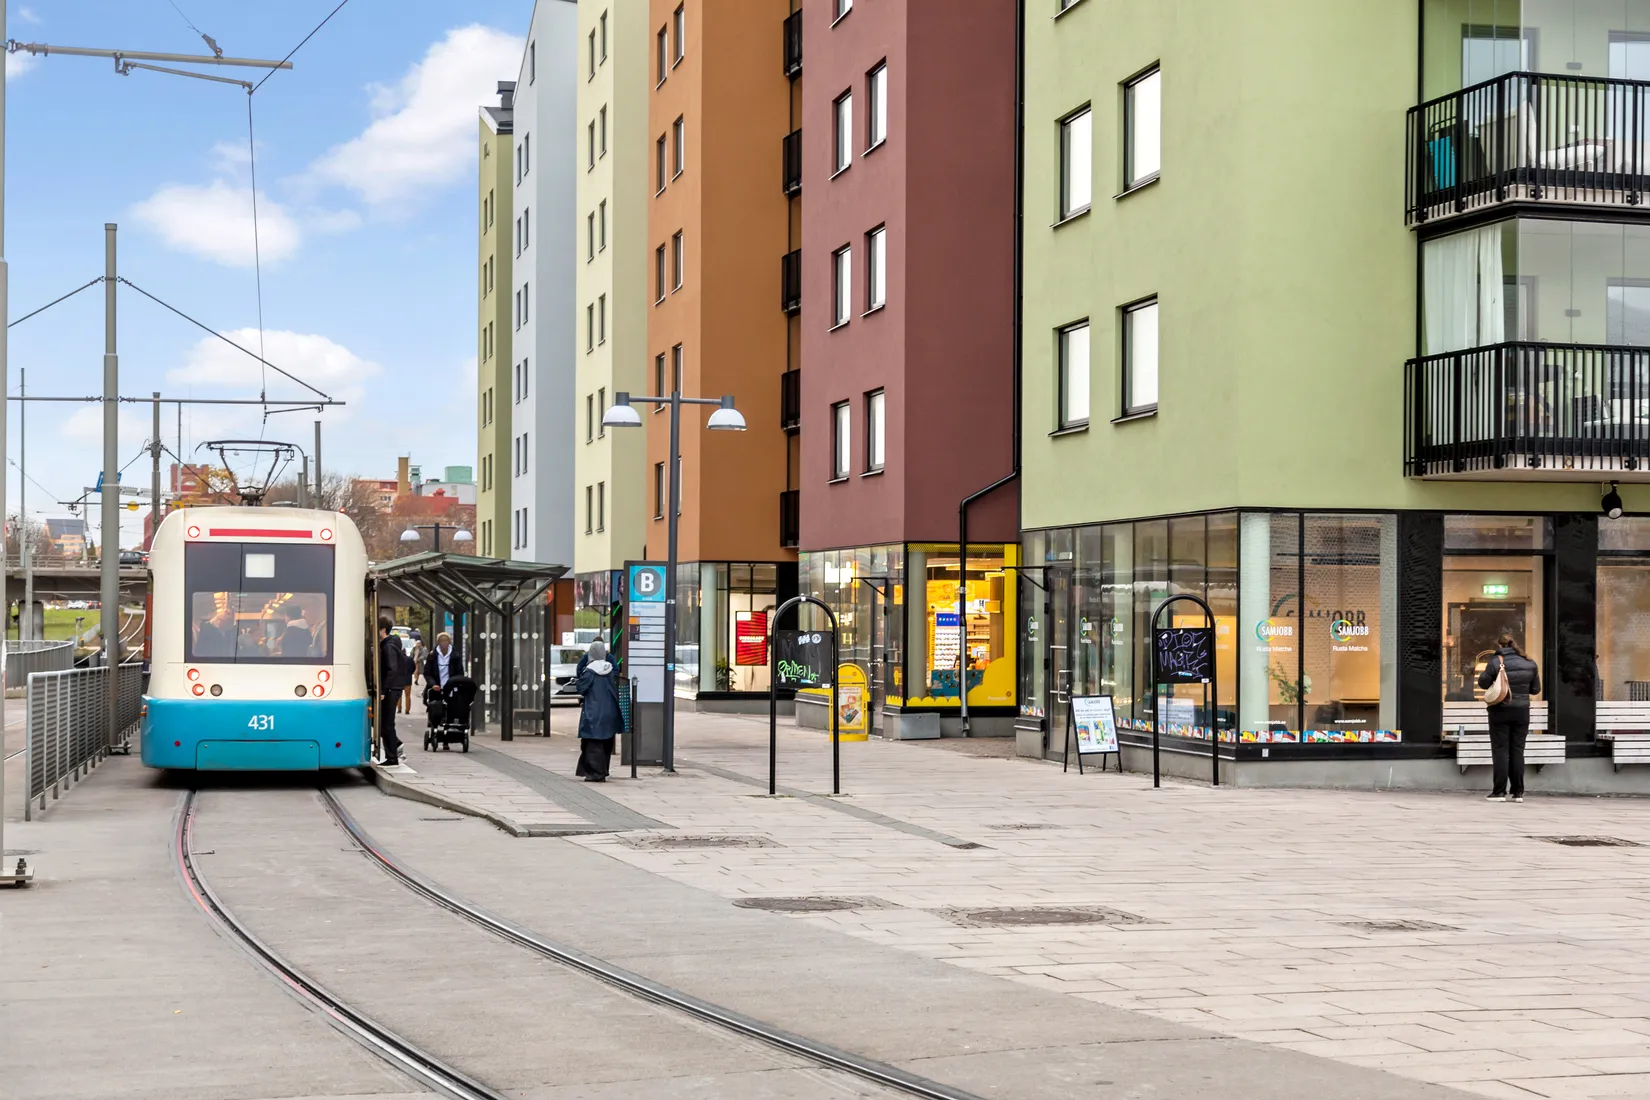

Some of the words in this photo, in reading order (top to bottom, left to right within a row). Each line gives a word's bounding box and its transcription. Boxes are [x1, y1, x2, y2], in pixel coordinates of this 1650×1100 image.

[641, 572, 654, 592] B
[1261, 626, 1293, 636] SAMJOBB
[1338, 626, 1369, 636] SAMJOBB
[247, 714, 275, 730] 431
